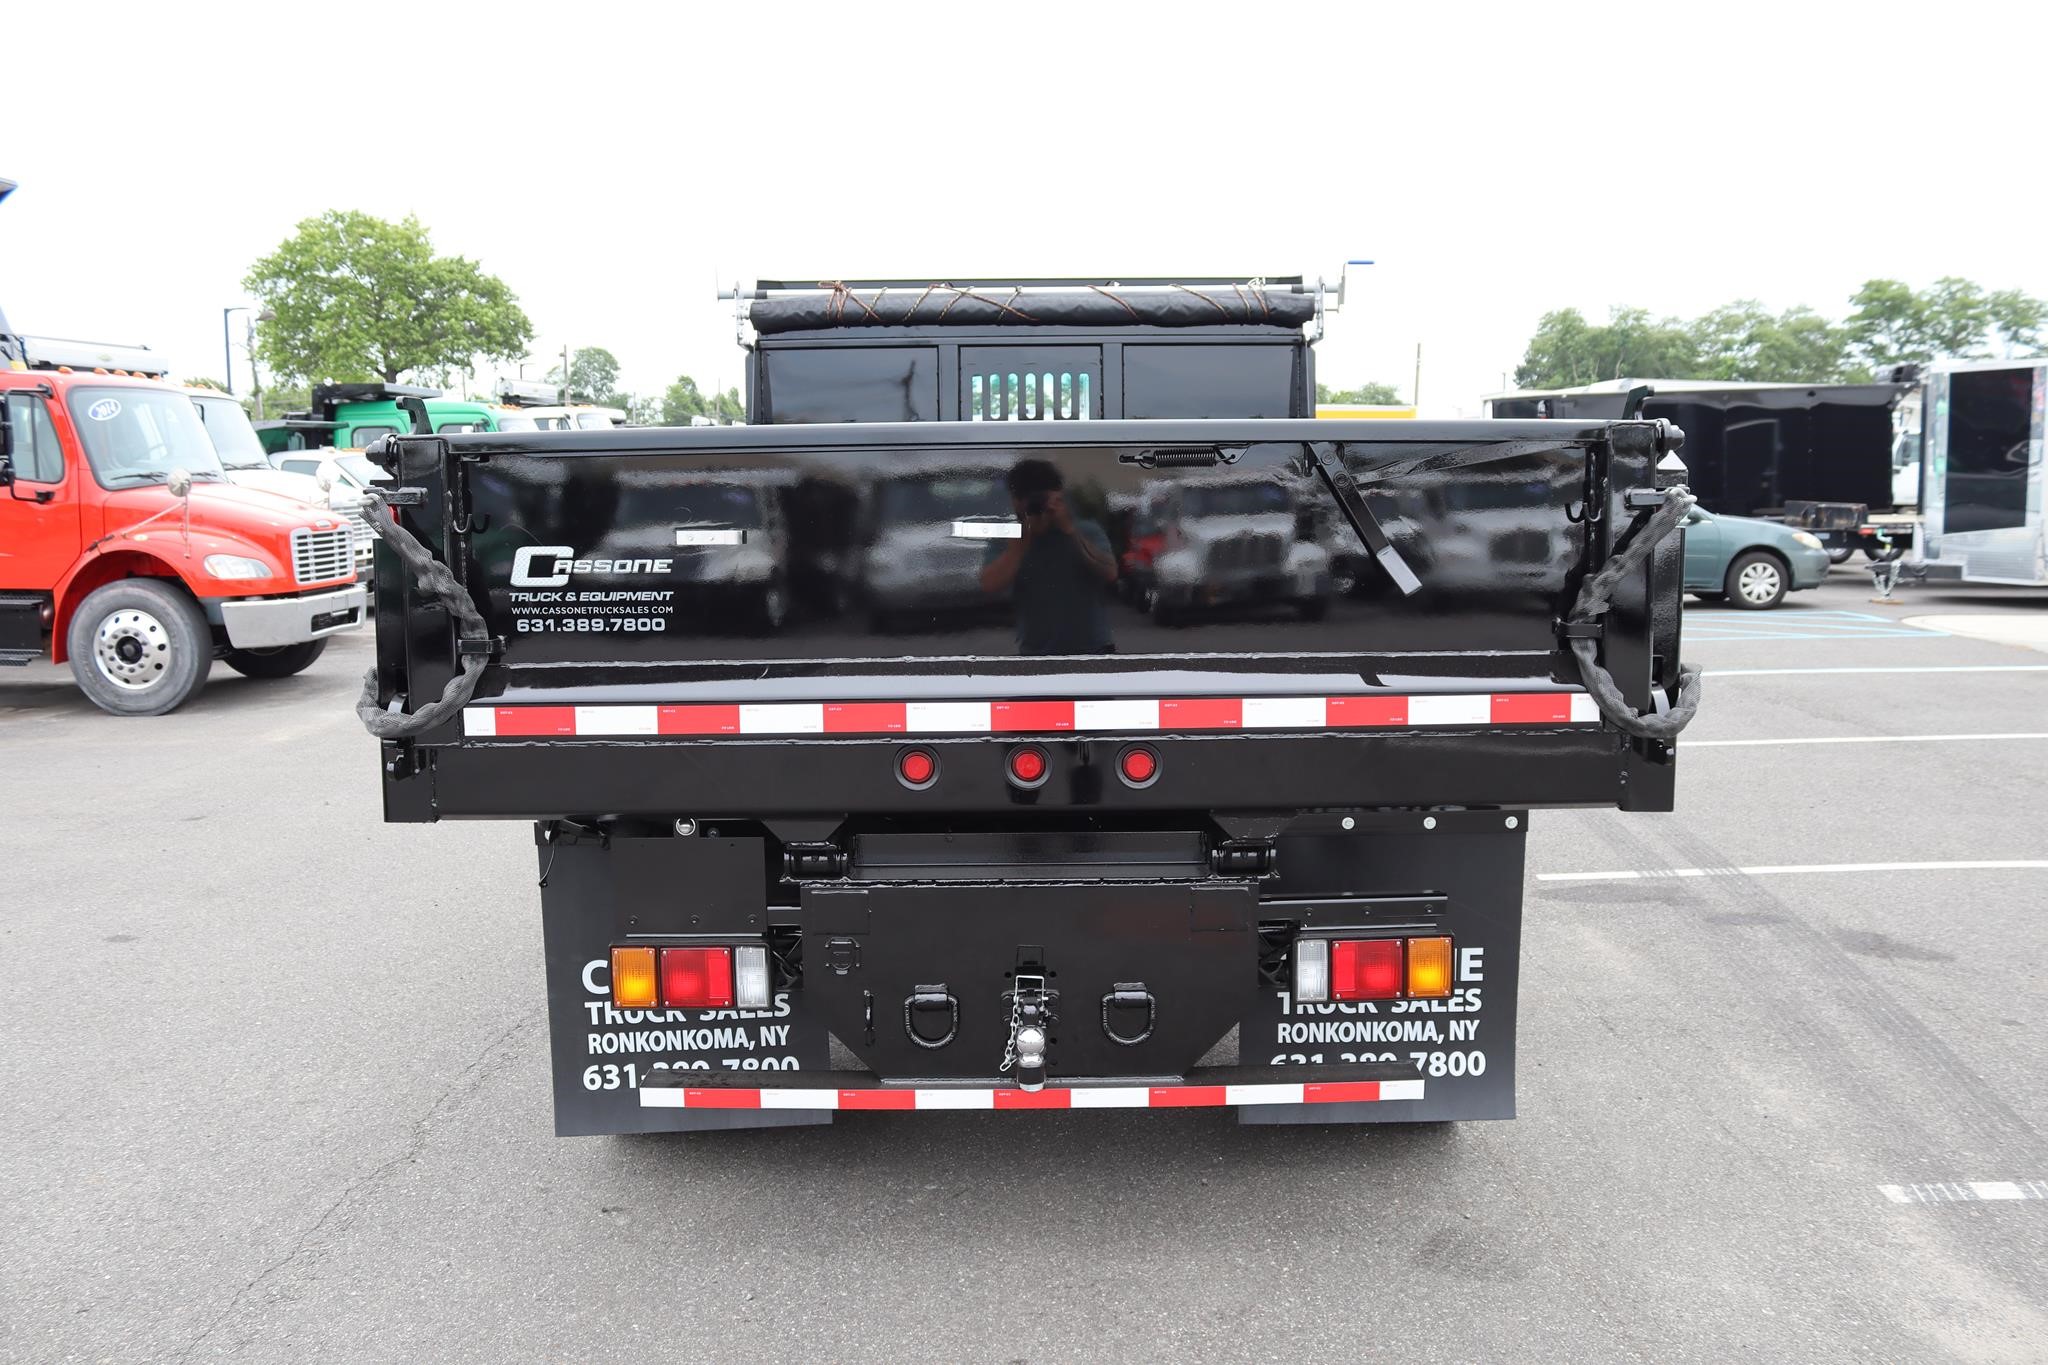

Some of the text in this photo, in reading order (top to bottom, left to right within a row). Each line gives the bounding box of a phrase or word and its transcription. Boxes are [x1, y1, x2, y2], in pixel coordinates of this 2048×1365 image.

[509, 591, 674, 602] TRUCK & EQUIPMENT
[516, 618, 666, 632] 631.389.7800
[588, 1024, 791, 1054] RONKONKOMA, NY
[1277, 1019, 1481, 1044] RONKONKOMA, NY
